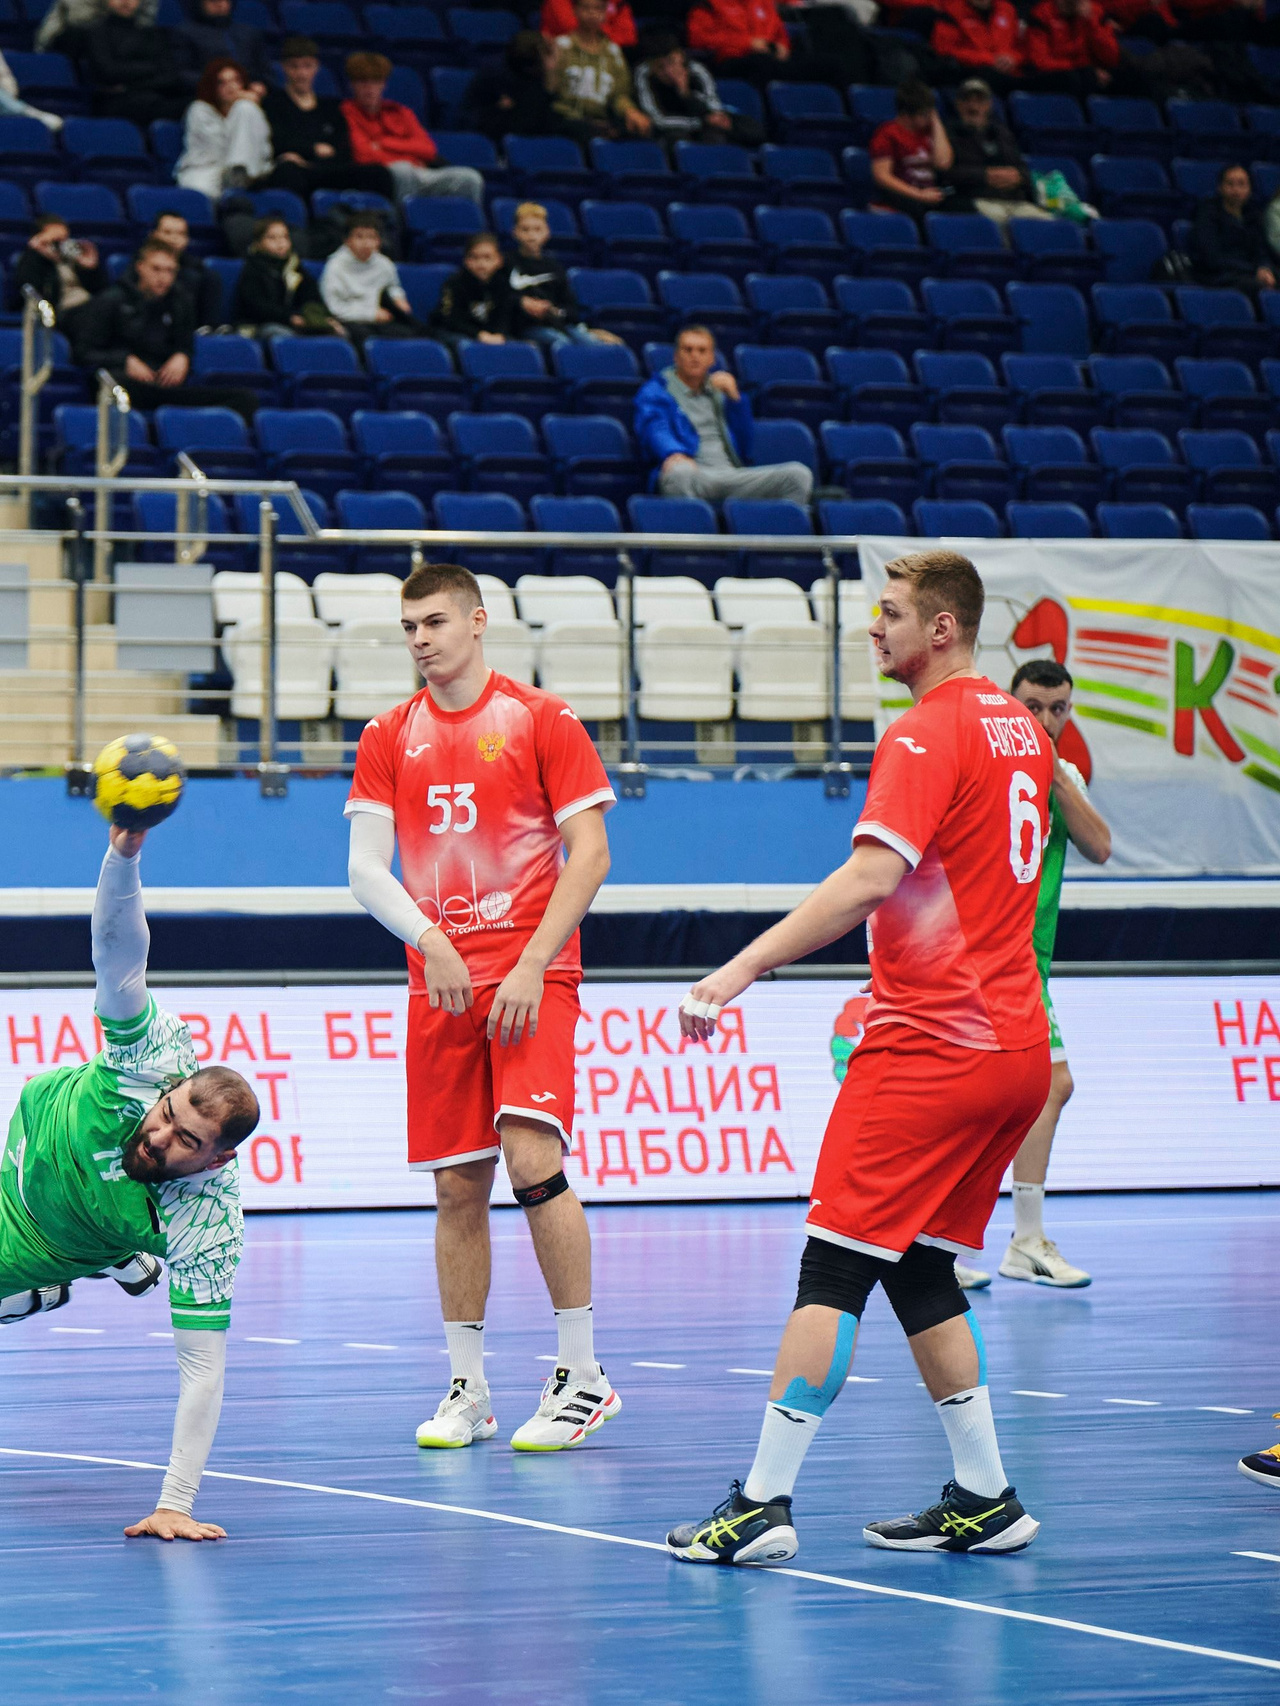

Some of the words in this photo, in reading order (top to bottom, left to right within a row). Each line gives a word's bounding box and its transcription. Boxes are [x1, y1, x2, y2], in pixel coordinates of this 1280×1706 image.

[427, 783, 478, 834] 53
[1009, 770, 1042, 884] 6
[7, 1013, 292, 1064] HABAL
